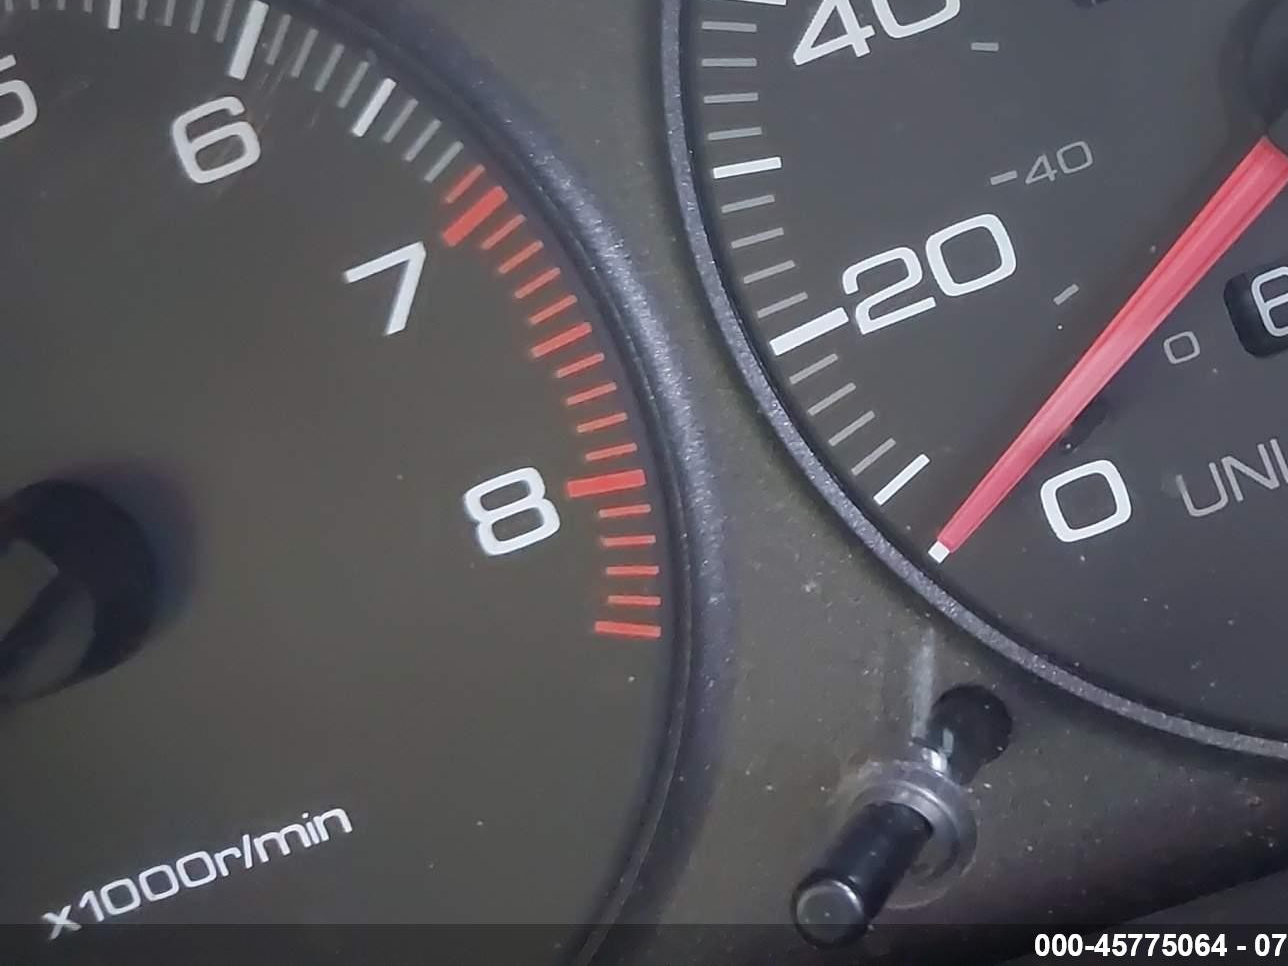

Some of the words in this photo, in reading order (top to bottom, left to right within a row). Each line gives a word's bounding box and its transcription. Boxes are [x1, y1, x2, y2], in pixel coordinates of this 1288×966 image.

[171, 95, 261, 184] 6
[1025, 141, 1093, 185] 40
[342, 241, 428, 335] 7
[842, 213, 1016, 335] 20
[1163, 330, 1201, 364] 0
[462, 466, 560, 556] 8
[1040, 459, 1132, 542] 0
[41, 806, 353, 939] x1000r/min
